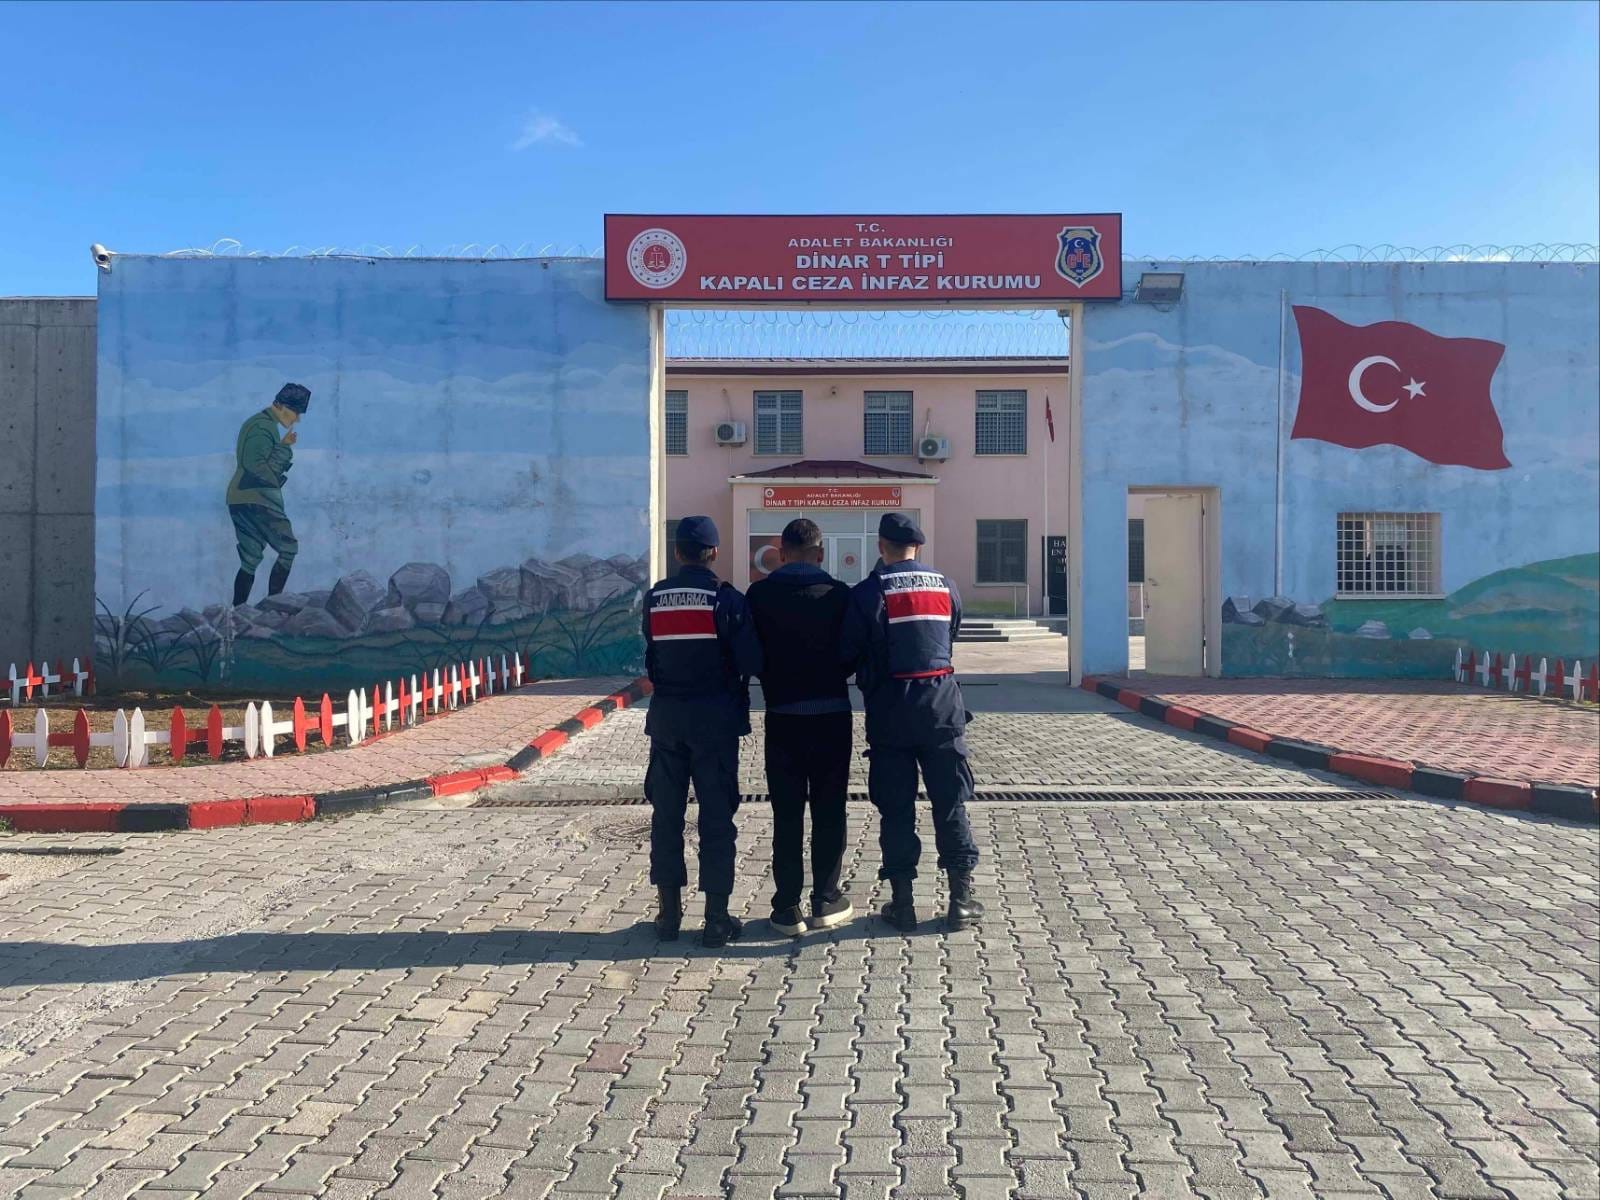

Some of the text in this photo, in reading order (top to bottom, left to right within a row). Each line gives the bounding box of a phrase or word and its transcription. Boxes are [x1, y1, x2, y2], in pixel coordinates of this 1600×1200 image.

[855, 223, 885, 233] T.C.
[788, 235, 953, 248] ADALET BAKANLIĞI
[796, 251, 944, 269] DİNAR T TİPİ
[700, 272, 1041, 290] KAPALI CEZA İNFAZ KURUMU
[890, 575, 945, 590] JANDARMA
[656, 592, 708, 607] JANDARMA
